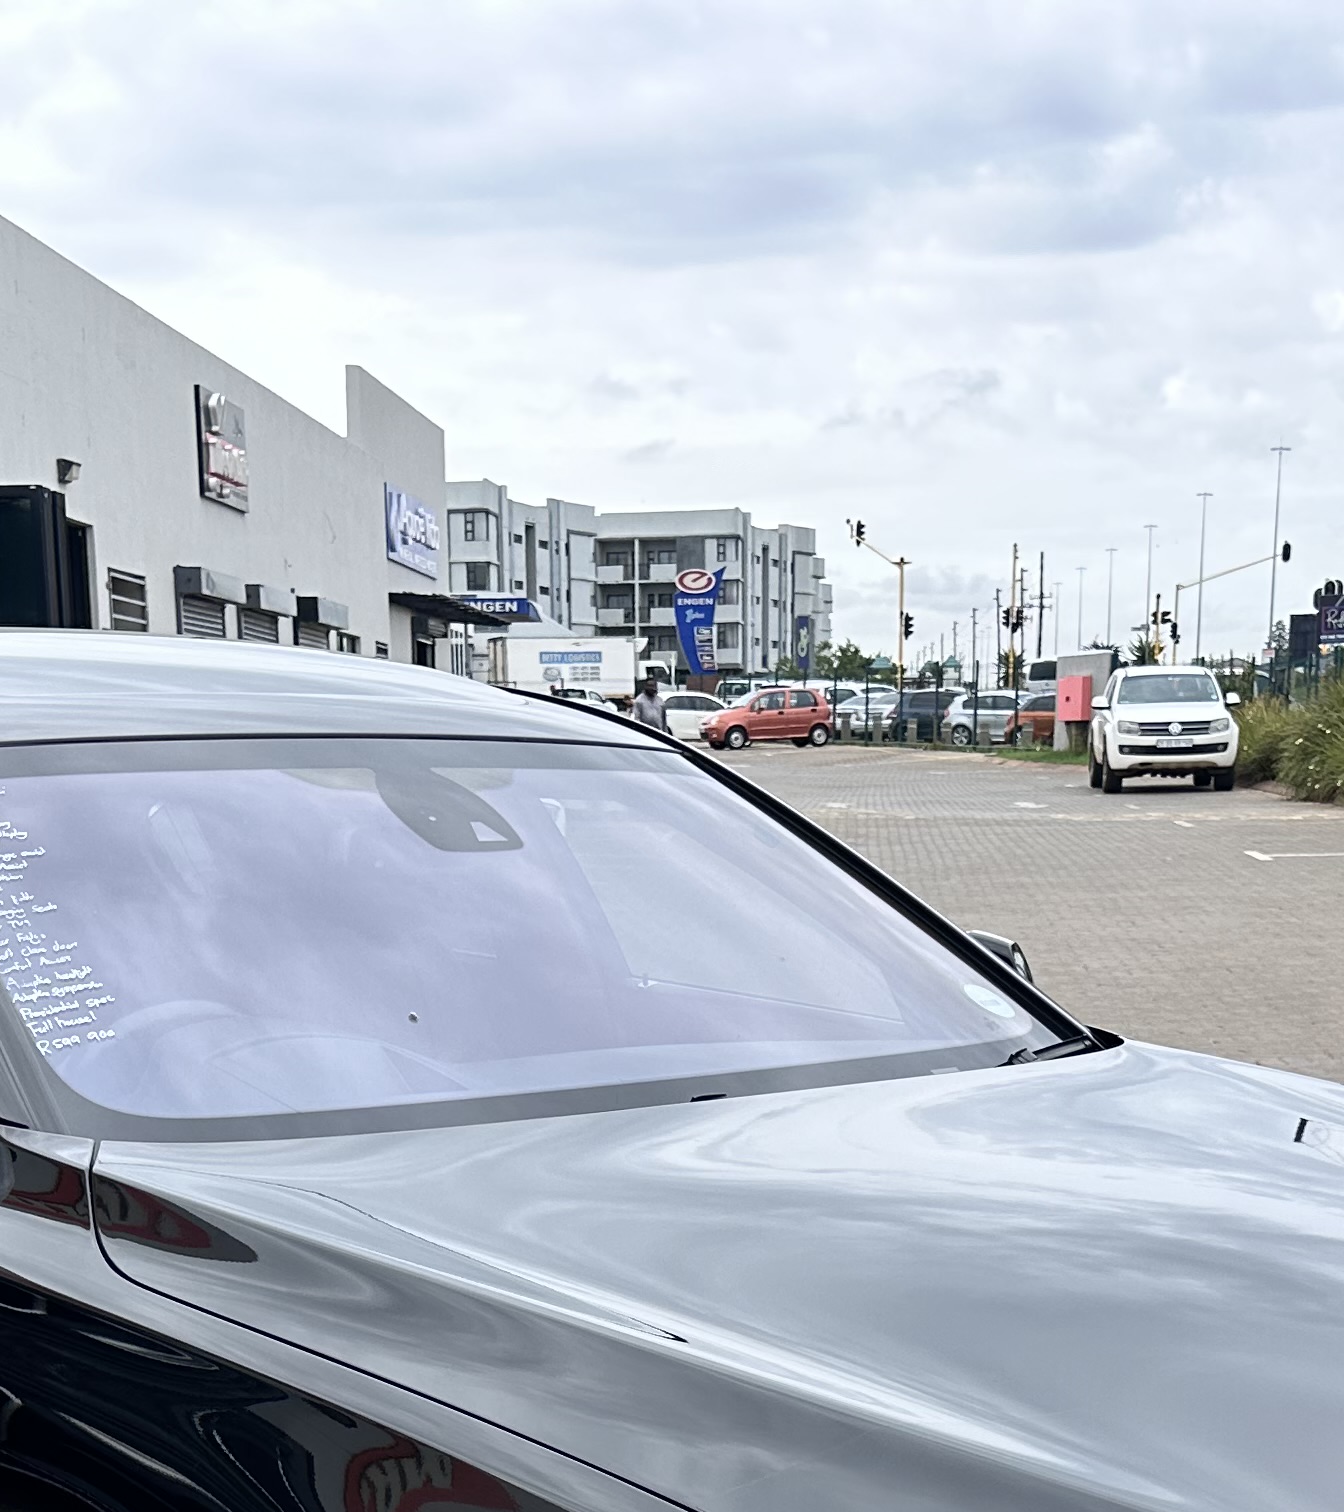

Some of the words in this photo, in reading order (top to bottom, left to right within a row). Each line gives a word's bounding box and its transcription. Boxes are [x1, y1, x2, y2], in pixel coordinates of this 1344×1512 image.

[463, 601, 518, 613] NGEN
[677, 597, 714, 606] ENGEN
[25, 1019, 54, 1038] Full
